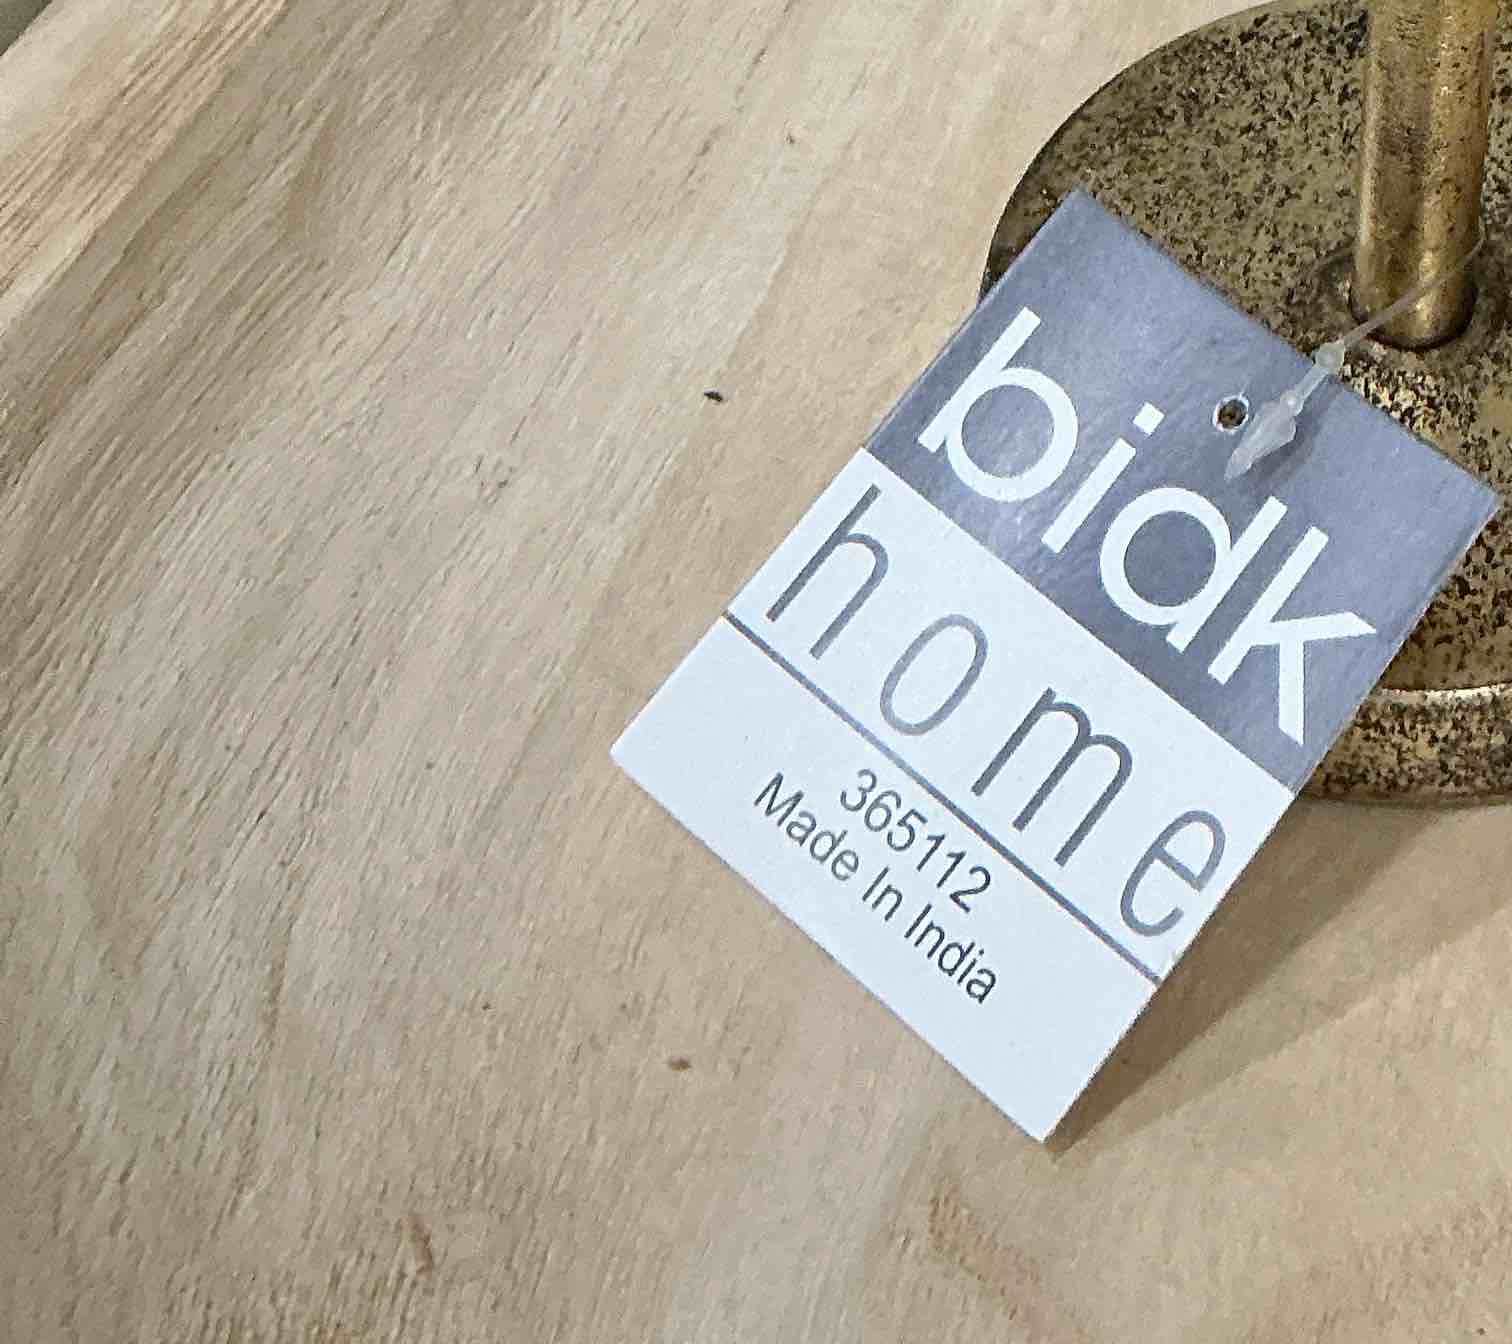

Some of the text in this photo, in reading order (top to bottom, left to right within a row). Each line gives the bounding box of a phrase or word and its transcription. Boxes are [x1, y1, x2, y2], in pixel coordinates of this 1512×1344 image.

[917, 306, 1376, 744] bidk
[765, 484, 1226, 937] home
[840, 768, 991, 913] 365112
[754, 772, 996, 1004] Made In India
